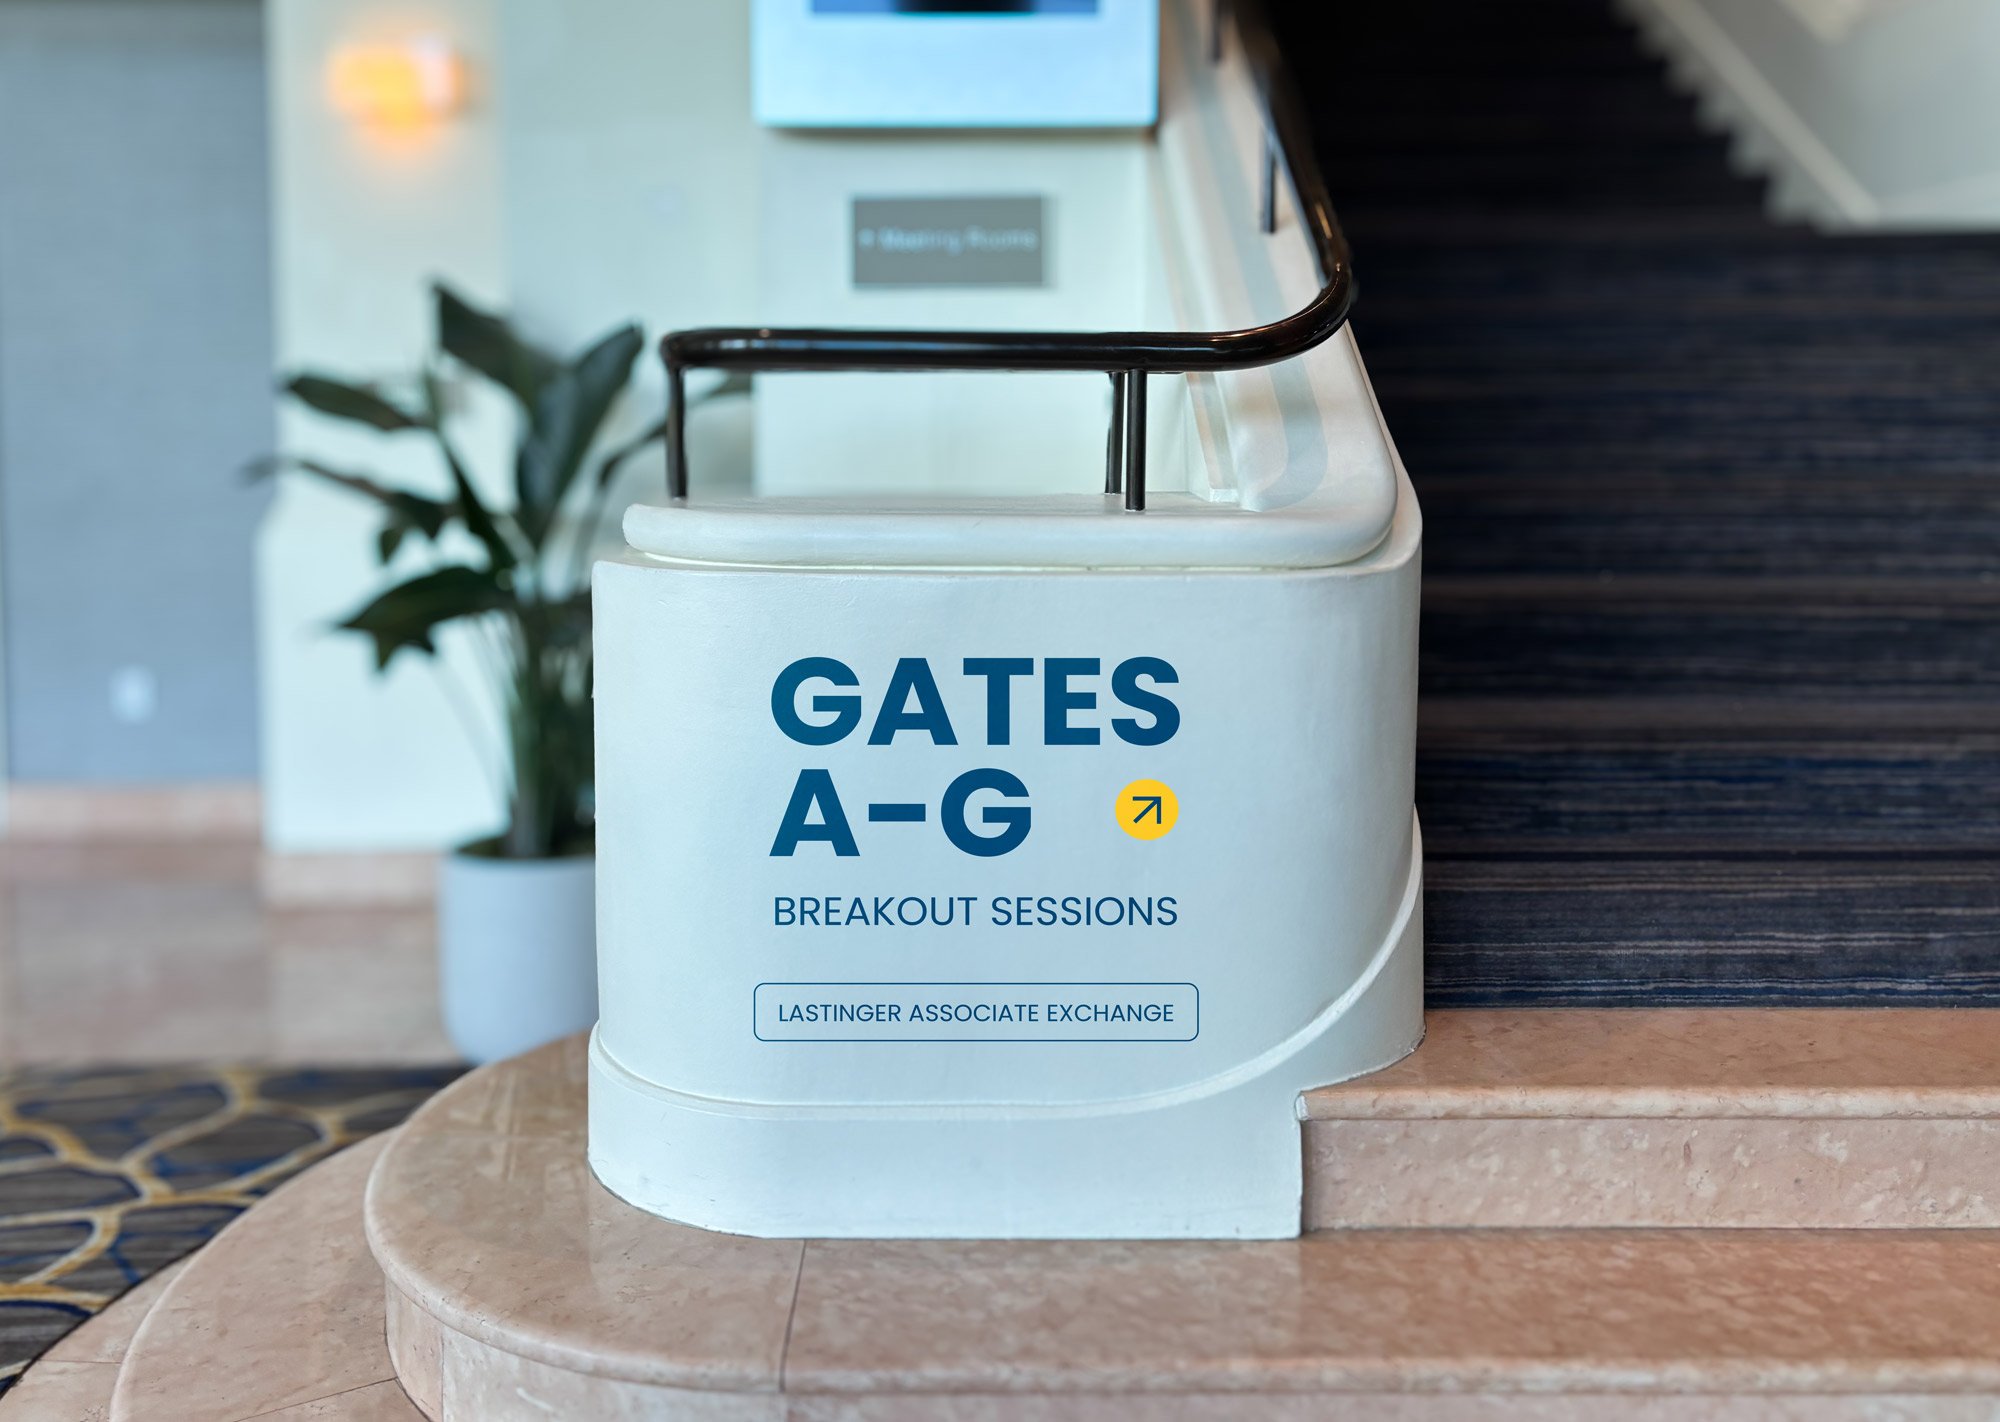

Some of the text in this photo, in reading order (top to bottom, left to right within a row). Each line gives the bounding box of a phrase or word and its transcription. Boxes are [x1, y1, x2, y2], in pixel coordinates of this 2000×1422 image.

[770, 656, 1181, 746] GATES
[774, 896, 1178, 926] BREAKOUT SESSIONS
[778, 1003, 1175, 1023] LASTINGER ASSOCIATE EXCHANGE
